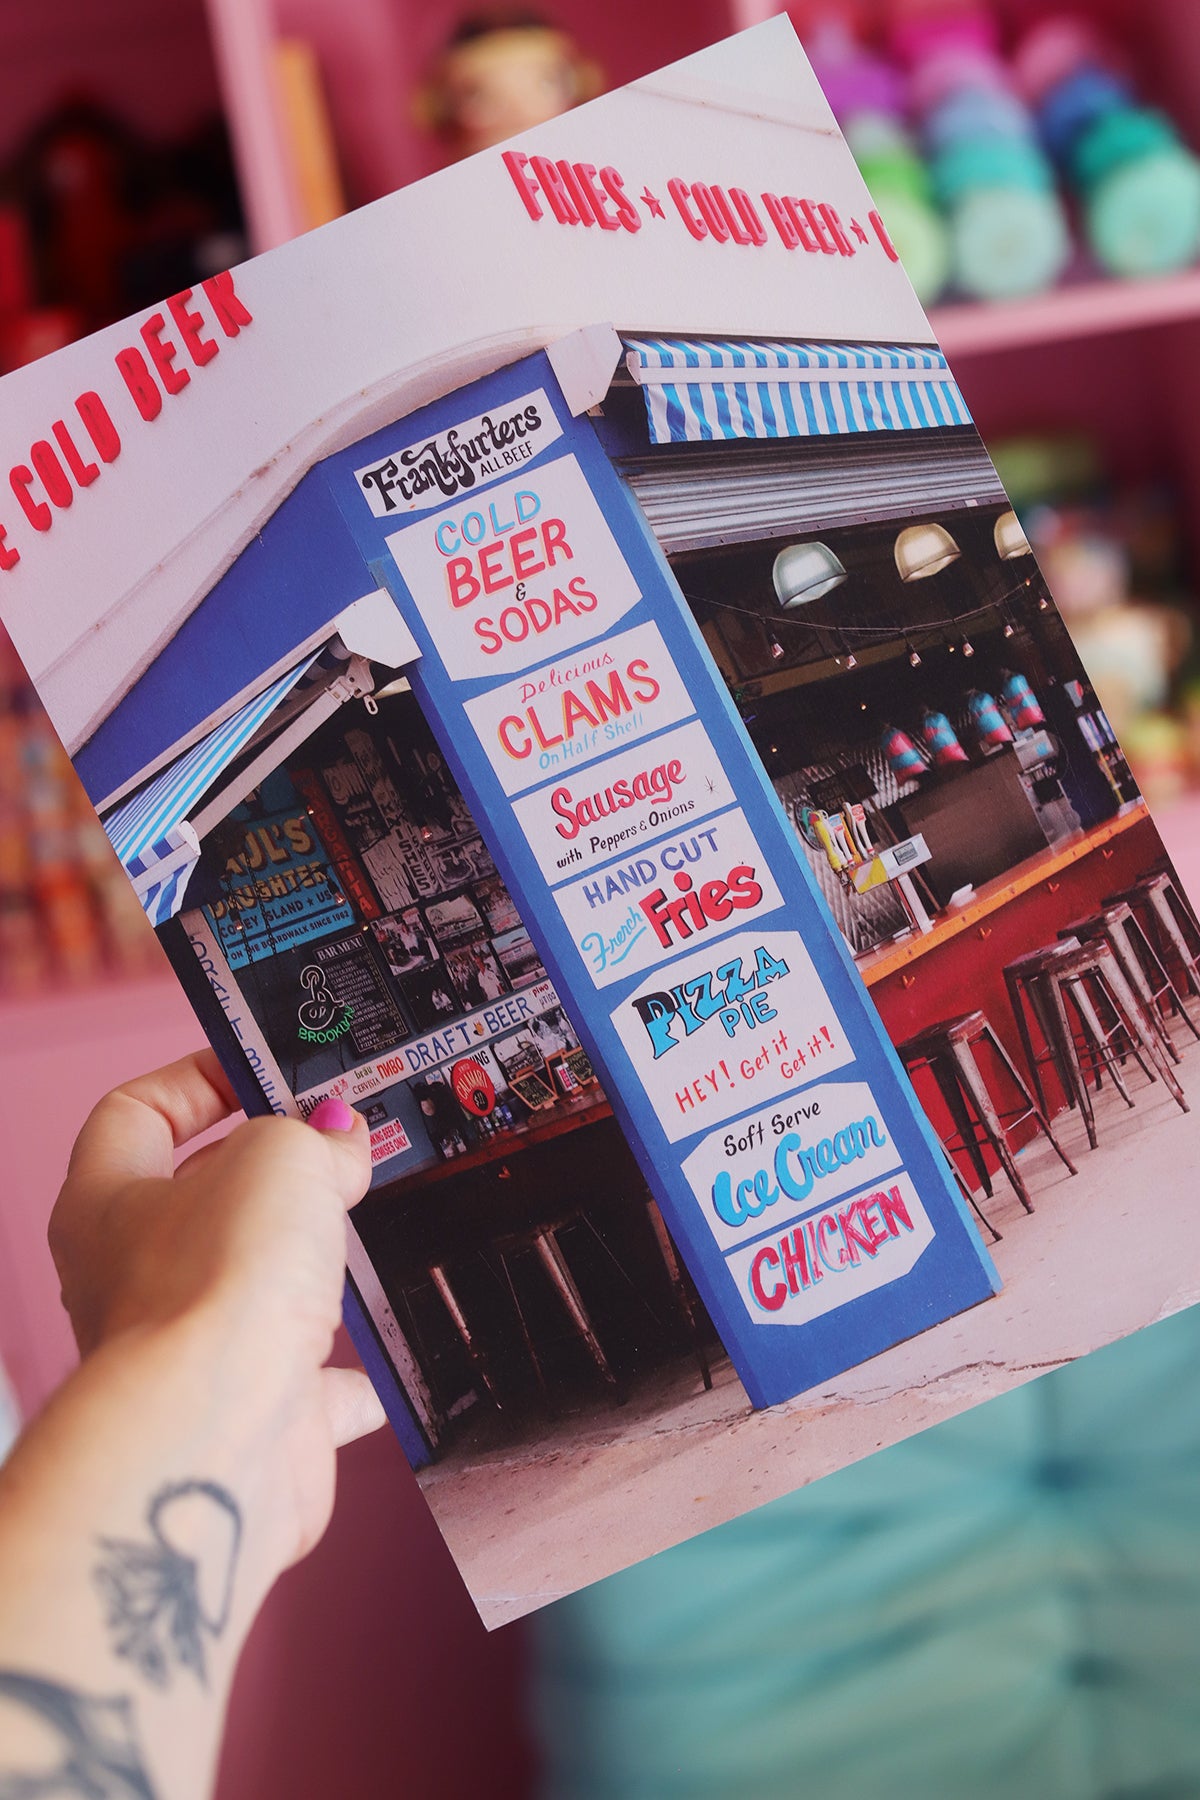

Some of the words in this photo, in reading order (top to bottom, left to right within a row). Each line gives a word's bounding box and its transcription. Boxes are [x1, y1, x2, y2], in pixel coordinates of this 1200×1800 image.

[502, 151, 642, 233] FRIES
[667, 177, 768, 246] COLD
[761, 193, 856, 257] BEER
[9, 391, 121, 531] COLD
[115, 270, 253, 422] BEER
[362, 405, 542, 511] Frankfurters
[480, 456, 505, 477] ALL
[505, 441, 534, 466] BEEF
[435, 490, 541, 557] COLD
[445, 518, 574, 609] BEER
[516, 583, 527, 601] &
[473, 576, 598, 655] SODAS
[498, 659, 660, 760] CLAMS
[518, 652, 615, 703] Delicious
[539, 750, 560, 770] On
[563, 730, 598, 761] Half
[606, 713, 644, 742] Shell
[551, 760, 687, 840] Sausage
[556, 847, 583, 869] with
[589, 825, 638, 854] Peppers
[639, 820, 647, 831] &
[648, 799, 695, 827] Onions
[224, 818, 313, 877] AUL'S
[582, 860, 657, 908] HAND
[660, 828, 720, 871] CUT
[207, 861, 335, 920] DAUGHTER
[580, 907, 645, 974] French
[638, 865, 763, 949] Fries
[220, 915, 261, 939] COEY
[230, 949, 244, 961] ON
[310, 914, 333, 931] SINCE
[317, 945, 339, 961] BAR
[339, 937, 362, 955] MENU
[298, 1005, 355, 1044] BROOKLYN
[532, 983, 550, 998] piwo
[632, 946, 790, 1060] PIZZA
[405, 1022, 475, 1071] DRAFT
[486, 997, 534, 1034] BEER
[780, 1049, 806, 1080] Get
[806, 1025, 836, 1060] it!
[456, 1067, 487, 1100] CALAMARI
[675, 1060, 736, 1114] HEY!
[740, 1051, 770, 1080] Get
[771, 1030, 788, 1056] it
[724, 1122, 764, 1157] Soft
[771, 1101, 822, 1136] Serve
[712, 1171, 781, 1227] Ice
[774, 1115, 886, 1202] Cream
[748, 1185, 914, 1311] CHICKEN
